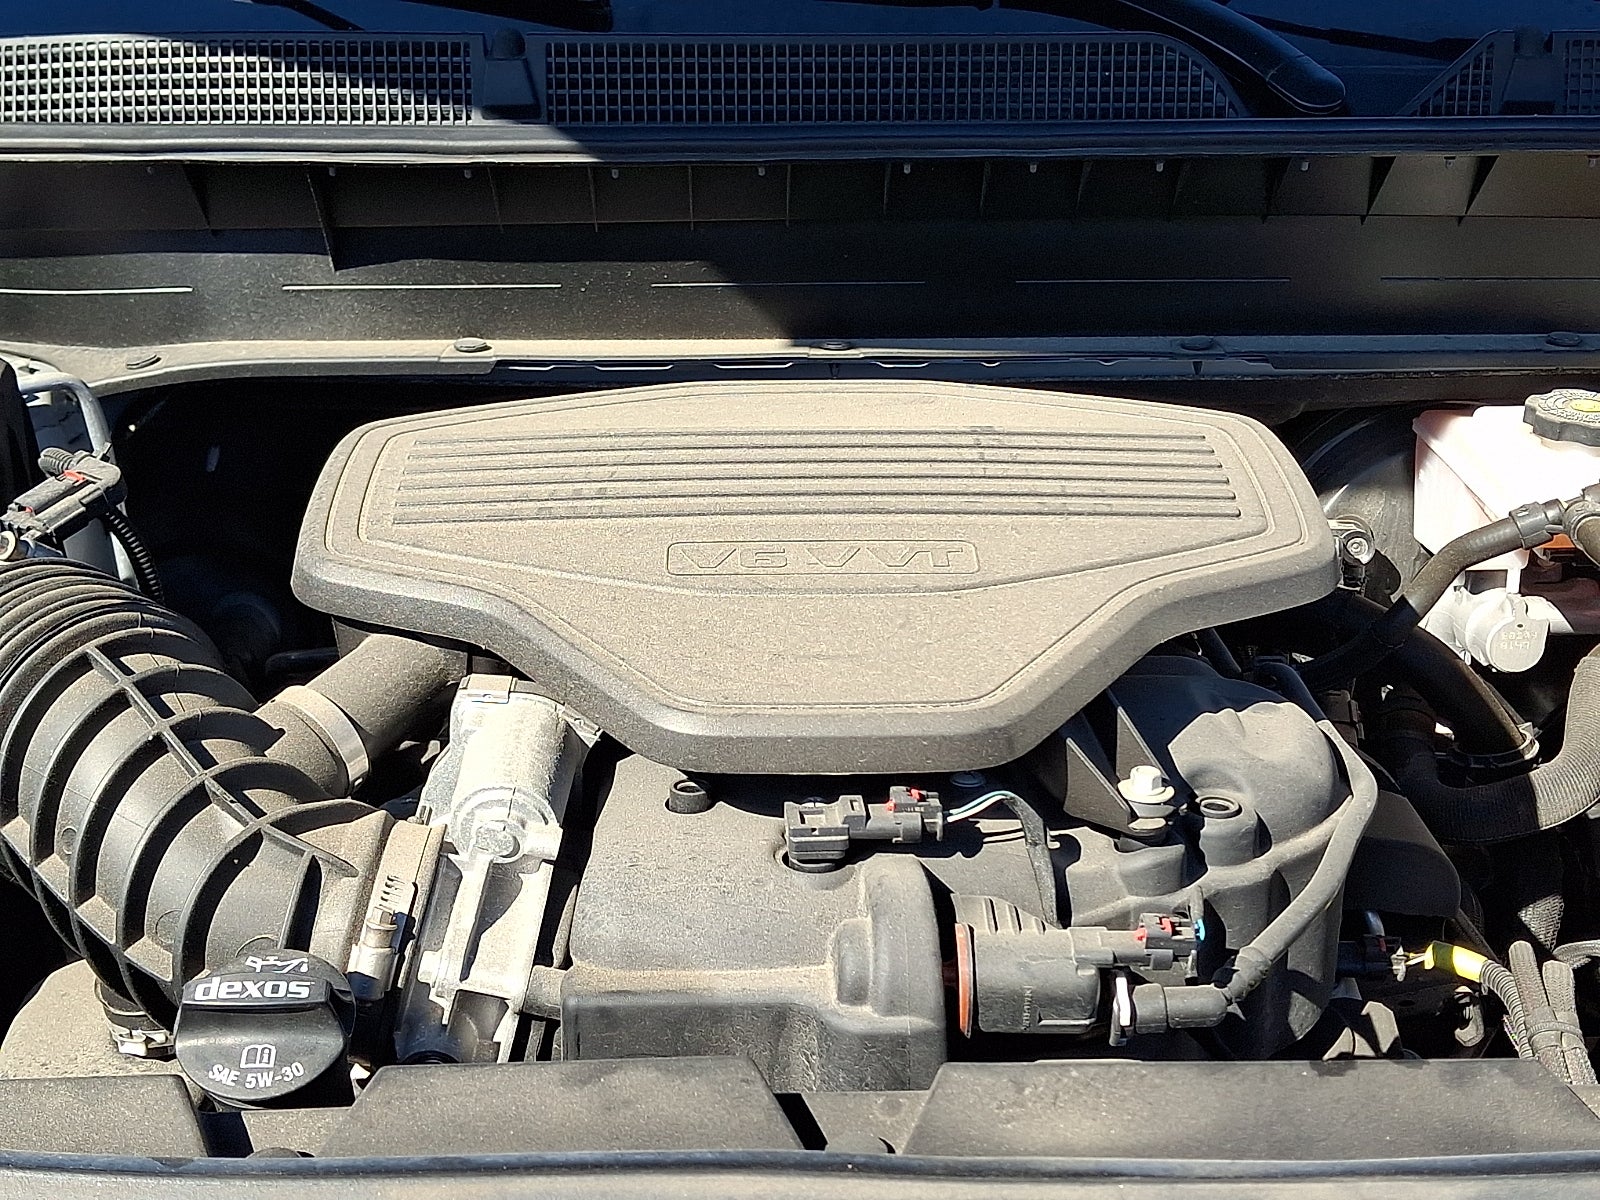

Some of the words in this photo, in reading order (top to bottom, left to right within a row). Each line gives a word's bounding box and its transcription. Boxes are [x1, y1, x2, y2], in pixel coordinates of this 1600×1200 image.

[680, 548, 788, 569] V6
[806, 547, 964, 568] VVT
[194, 976, 310, 1001] dexos
[208, 1063, 241, 1087] SAE
[244, 1061, 305, 1089] 5W-30
